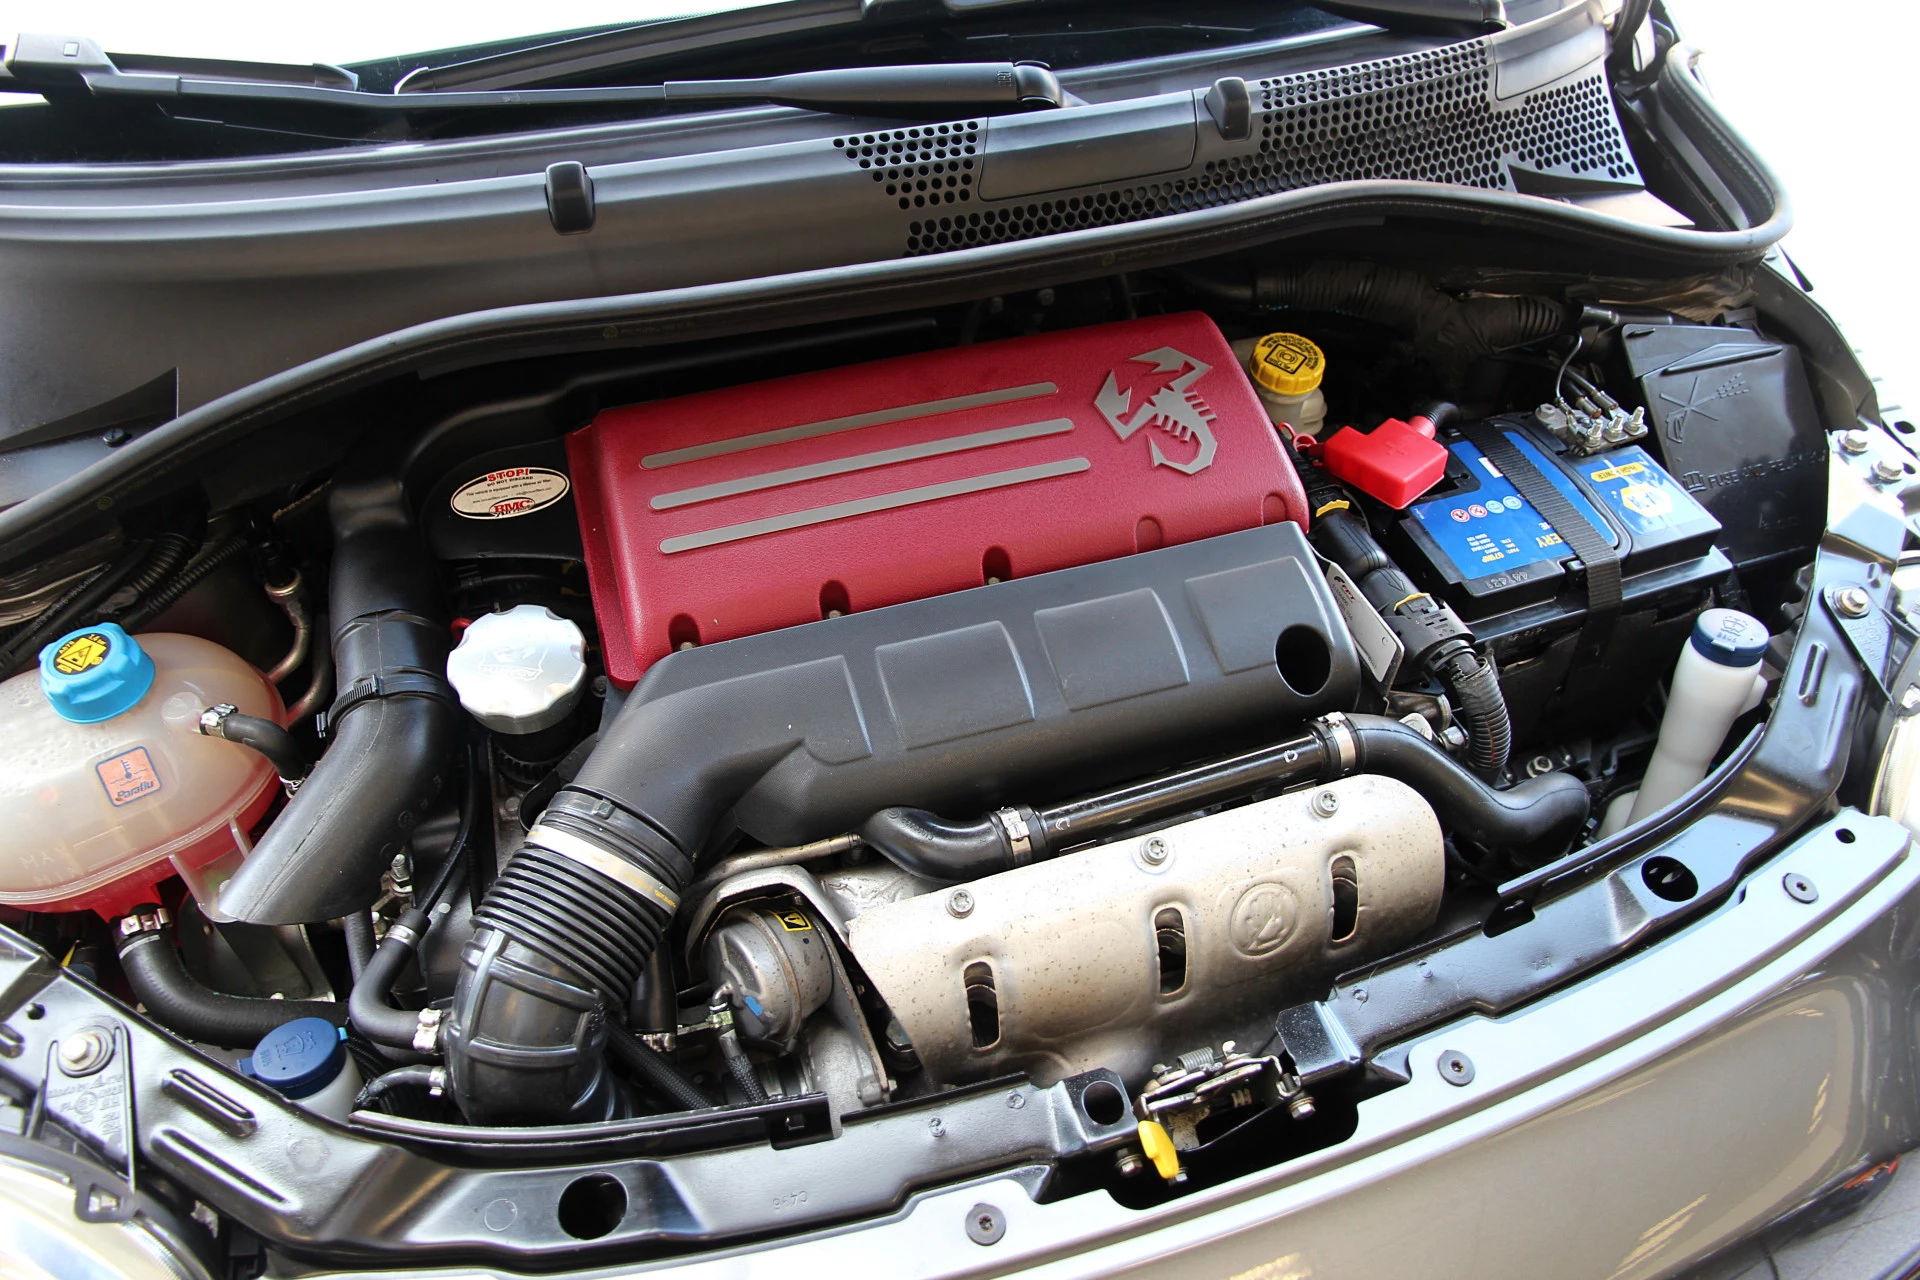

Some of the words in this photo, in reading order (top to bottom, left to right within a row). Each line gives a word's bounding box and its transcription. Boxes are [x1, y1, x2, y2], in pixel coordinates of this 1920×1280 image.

[487, 468, 529, 482] STOP!
[1708, 470, 1740, 488] FUSE
[117, 781, 154, 798] Paraflu
